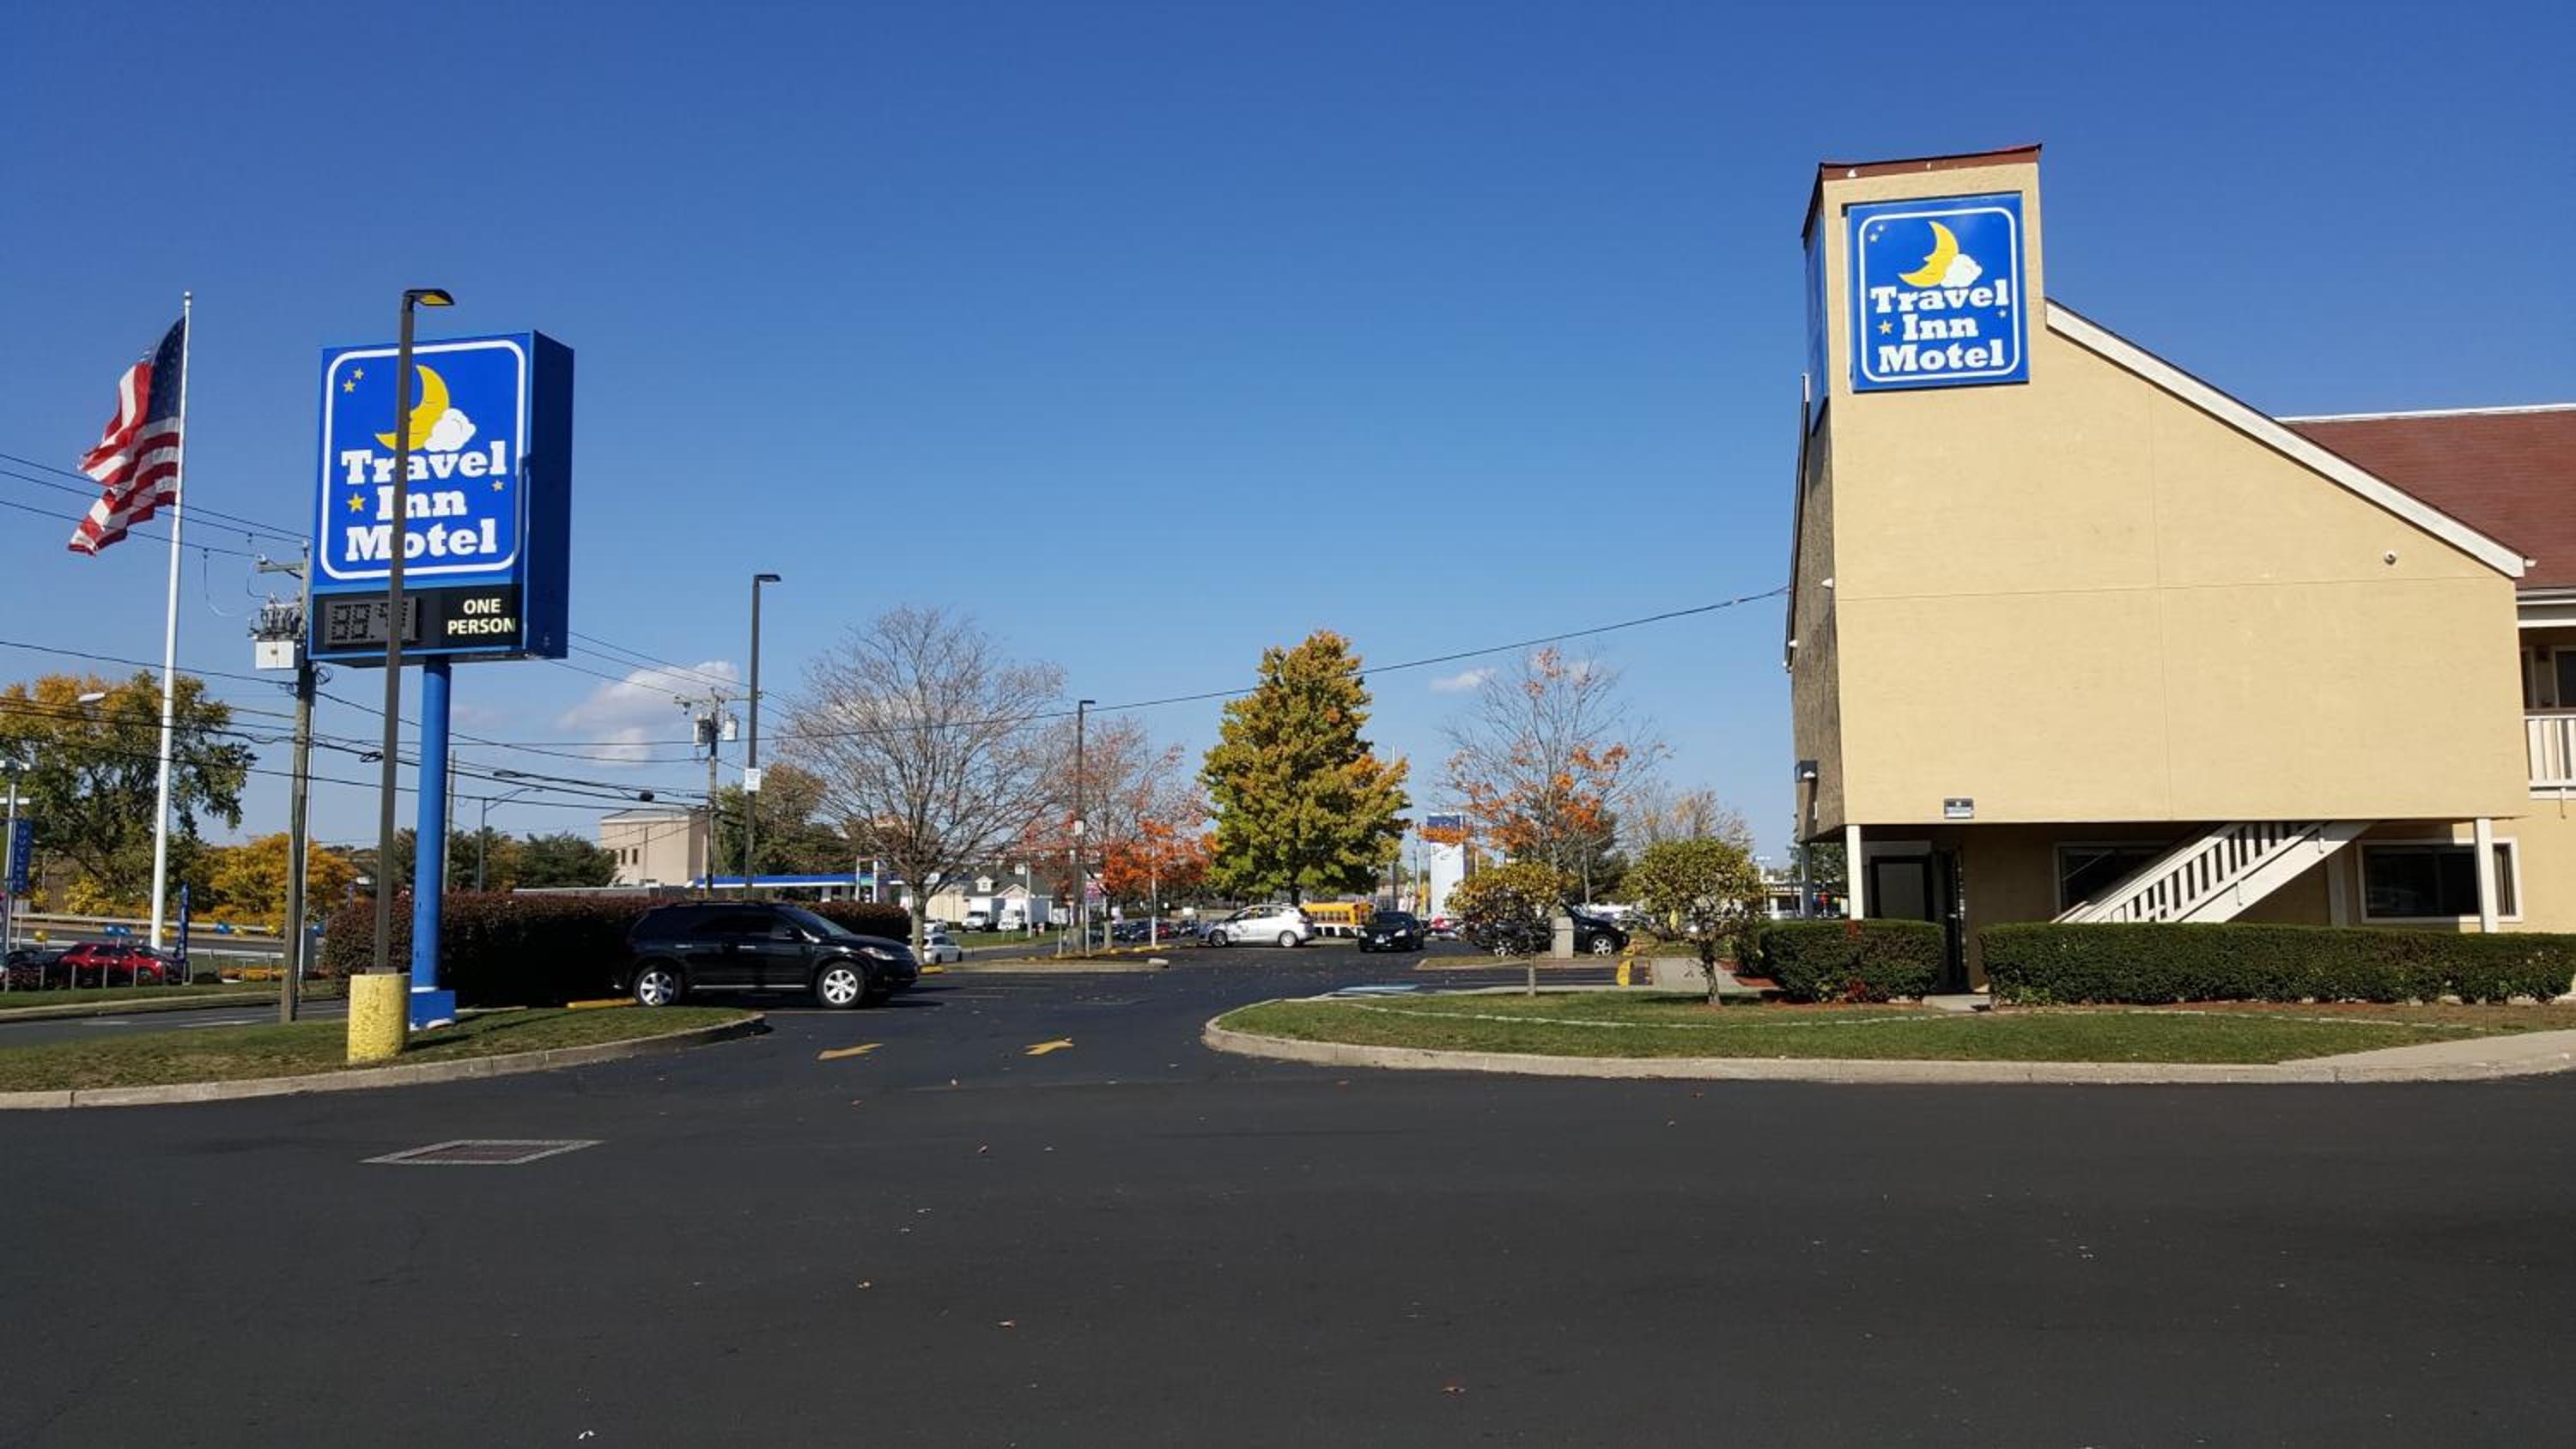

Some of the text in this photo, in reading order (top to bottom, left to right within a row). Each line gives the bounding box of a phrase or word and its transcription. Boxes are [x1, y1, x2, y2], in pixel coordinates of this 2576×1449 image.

[1870, 279, 2009, 314] Travel
[1902, 313, 1978, 342] Inn
[1878, 339, 2005, 373] Motel
[341, 440, 507, 485] Travel
[376, 485, 468, 521] Inn
[345, 518, 497, 562] Motel
[463, 598, 501, 615] ONE
[447, 617, 516, 635] PERSON
